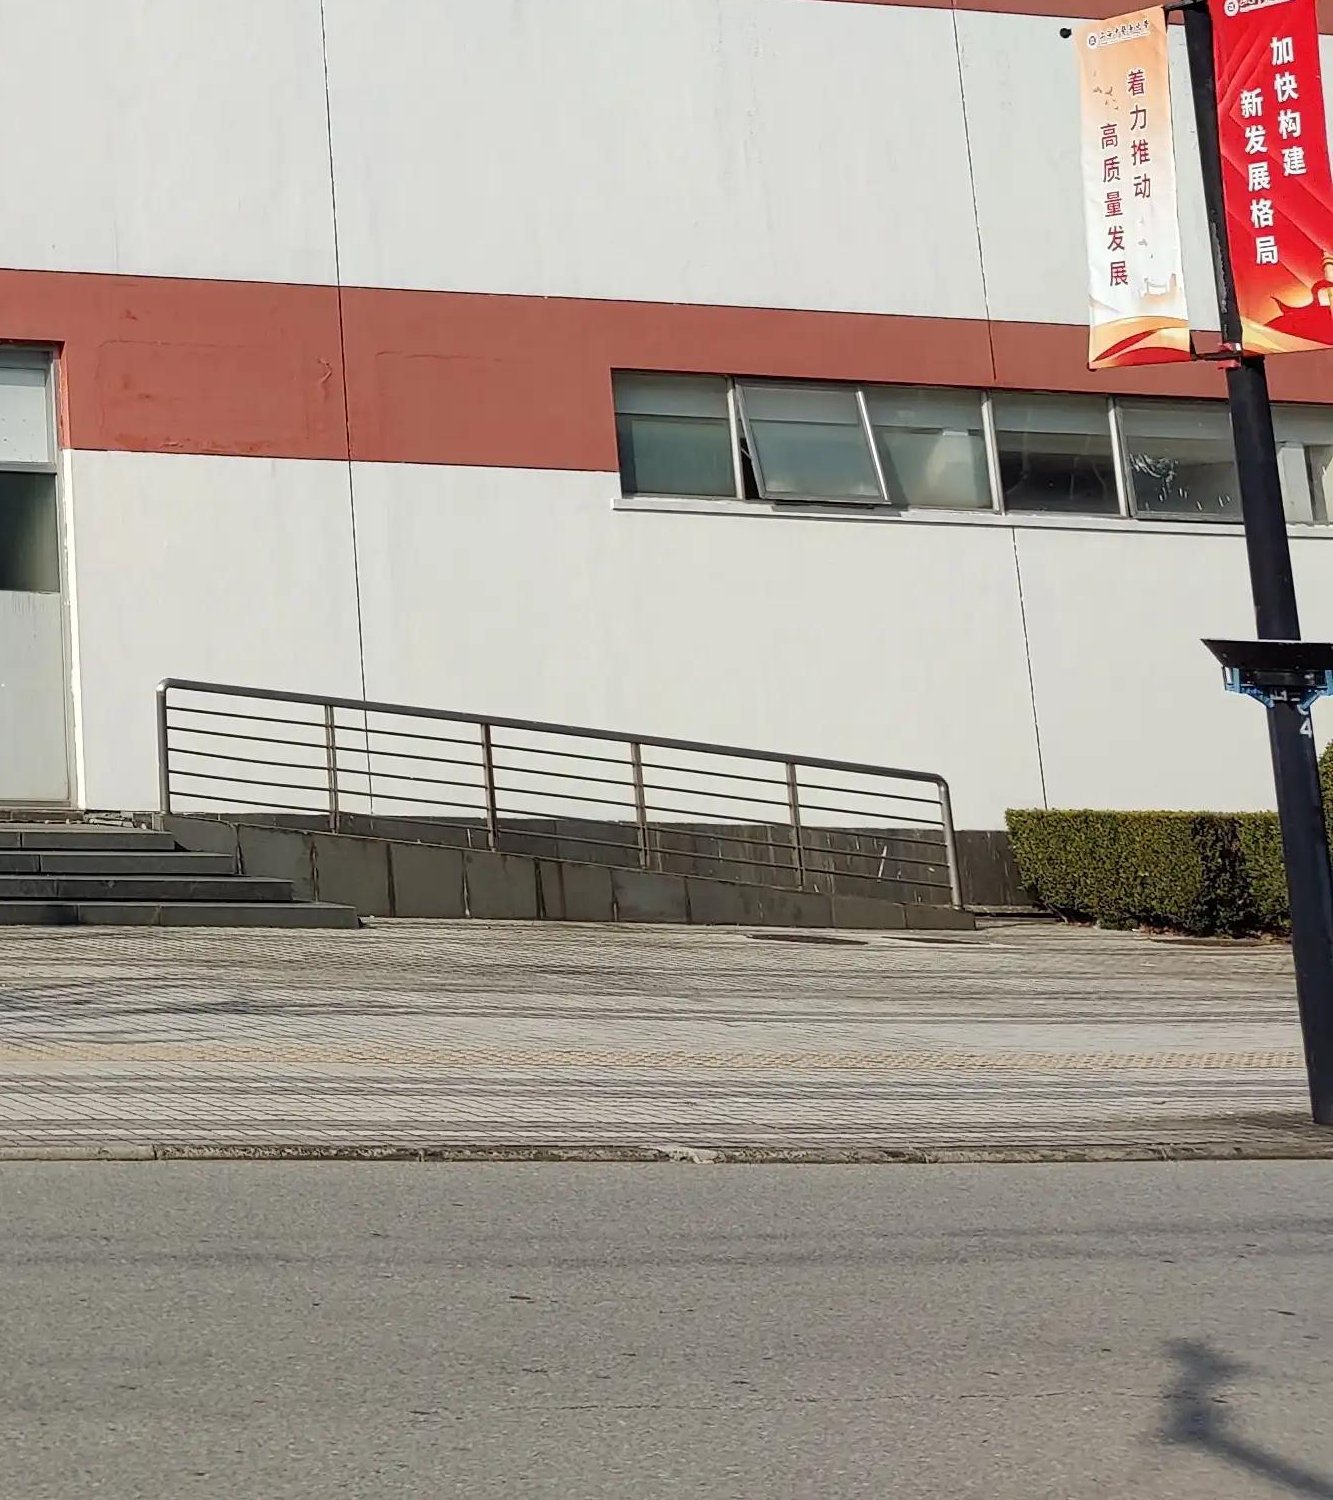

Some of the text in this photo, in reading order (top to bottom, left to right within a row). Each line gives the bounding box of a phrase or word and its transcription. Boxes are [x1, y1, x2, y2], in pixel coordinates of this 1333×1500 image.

[1127, 69, 1151, 199] 着力推动
[1239, 87, 1279, 266] 新发展格局
[1270, 36, 1308, 177] 加快构建
[1100, 122, 1129, 287] 高质量发展
